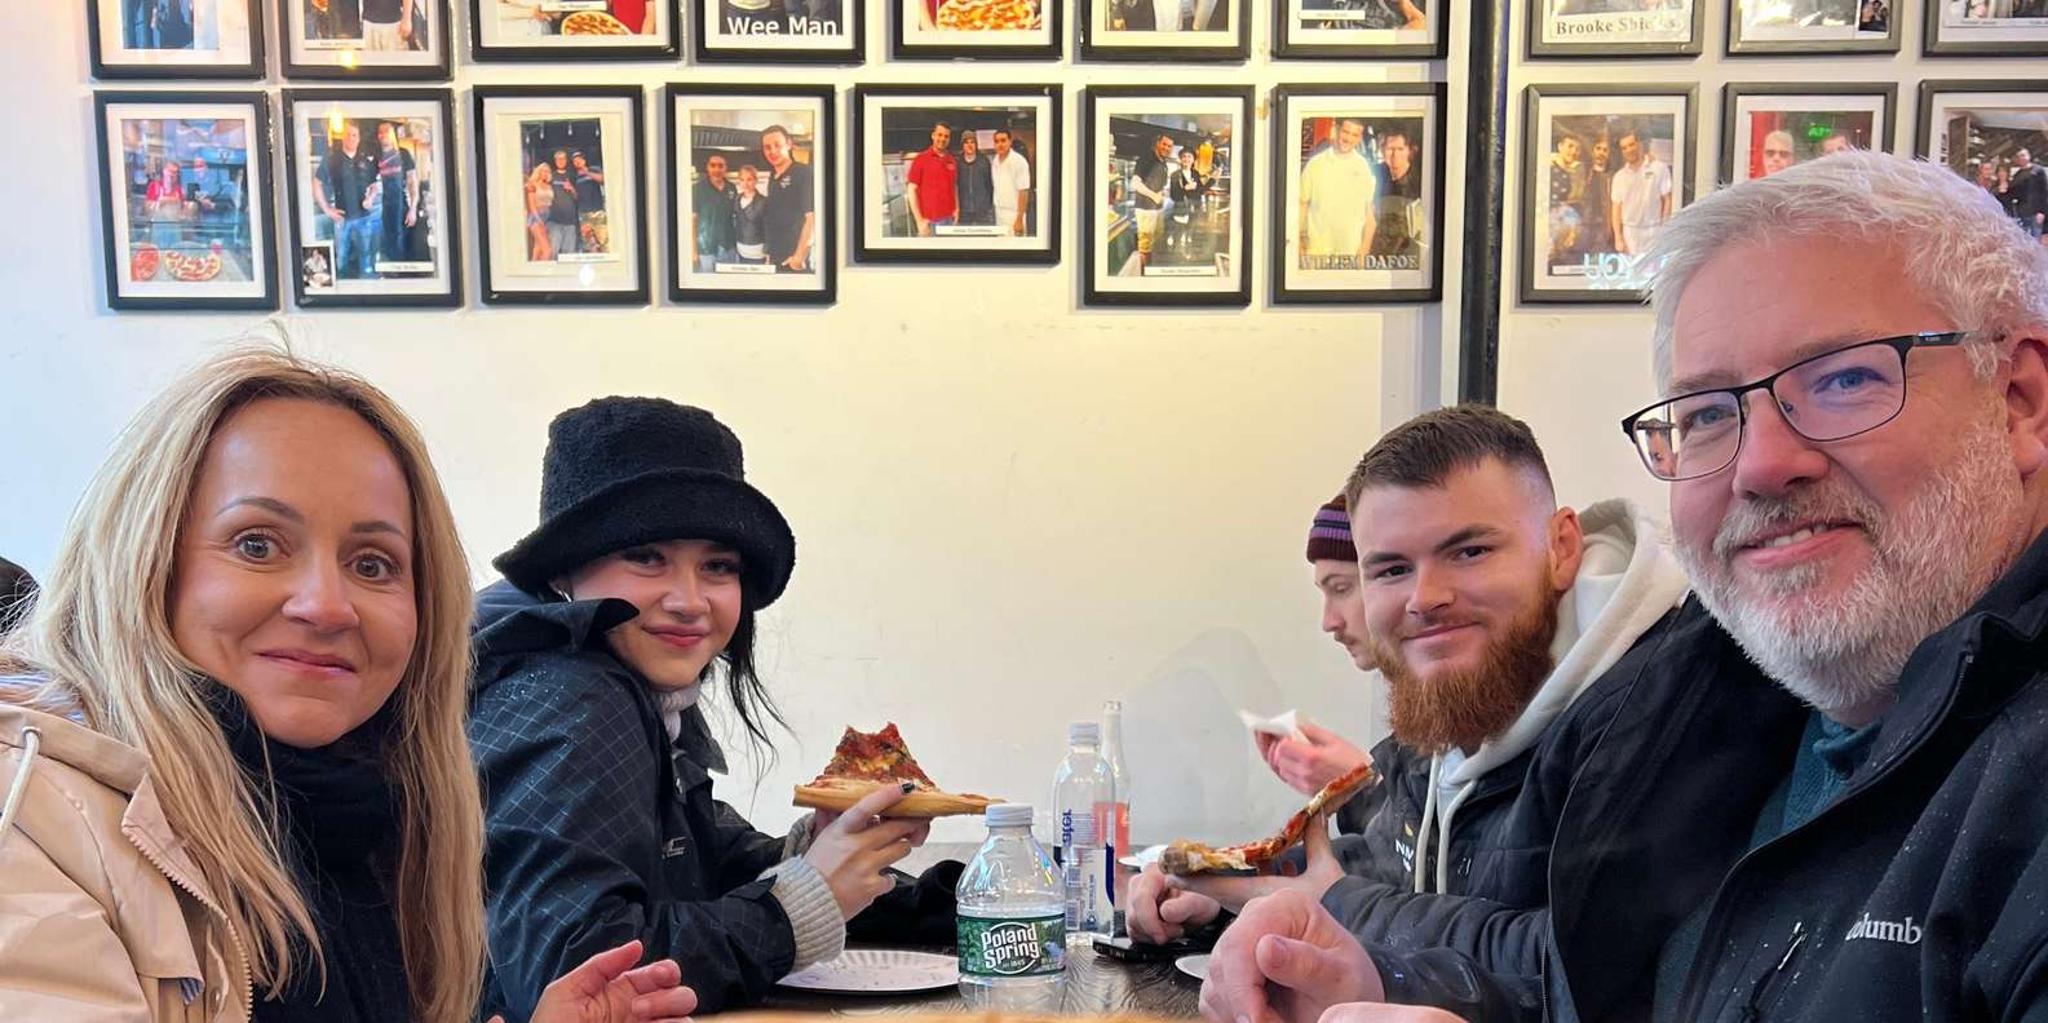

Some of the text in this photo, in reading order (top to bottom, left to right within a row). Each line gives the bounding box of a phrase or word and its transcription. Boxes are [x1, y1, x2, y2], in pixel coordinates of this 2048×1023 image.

[727, 16, 837, 36] Wee Man
[1556, 17, 1677, 35] Brooke Shies
[1365, 254, 1418, 270] DAFOE
[981, 922, 1037, 951] Poland
[983, 941, 1040, 970] Spring
